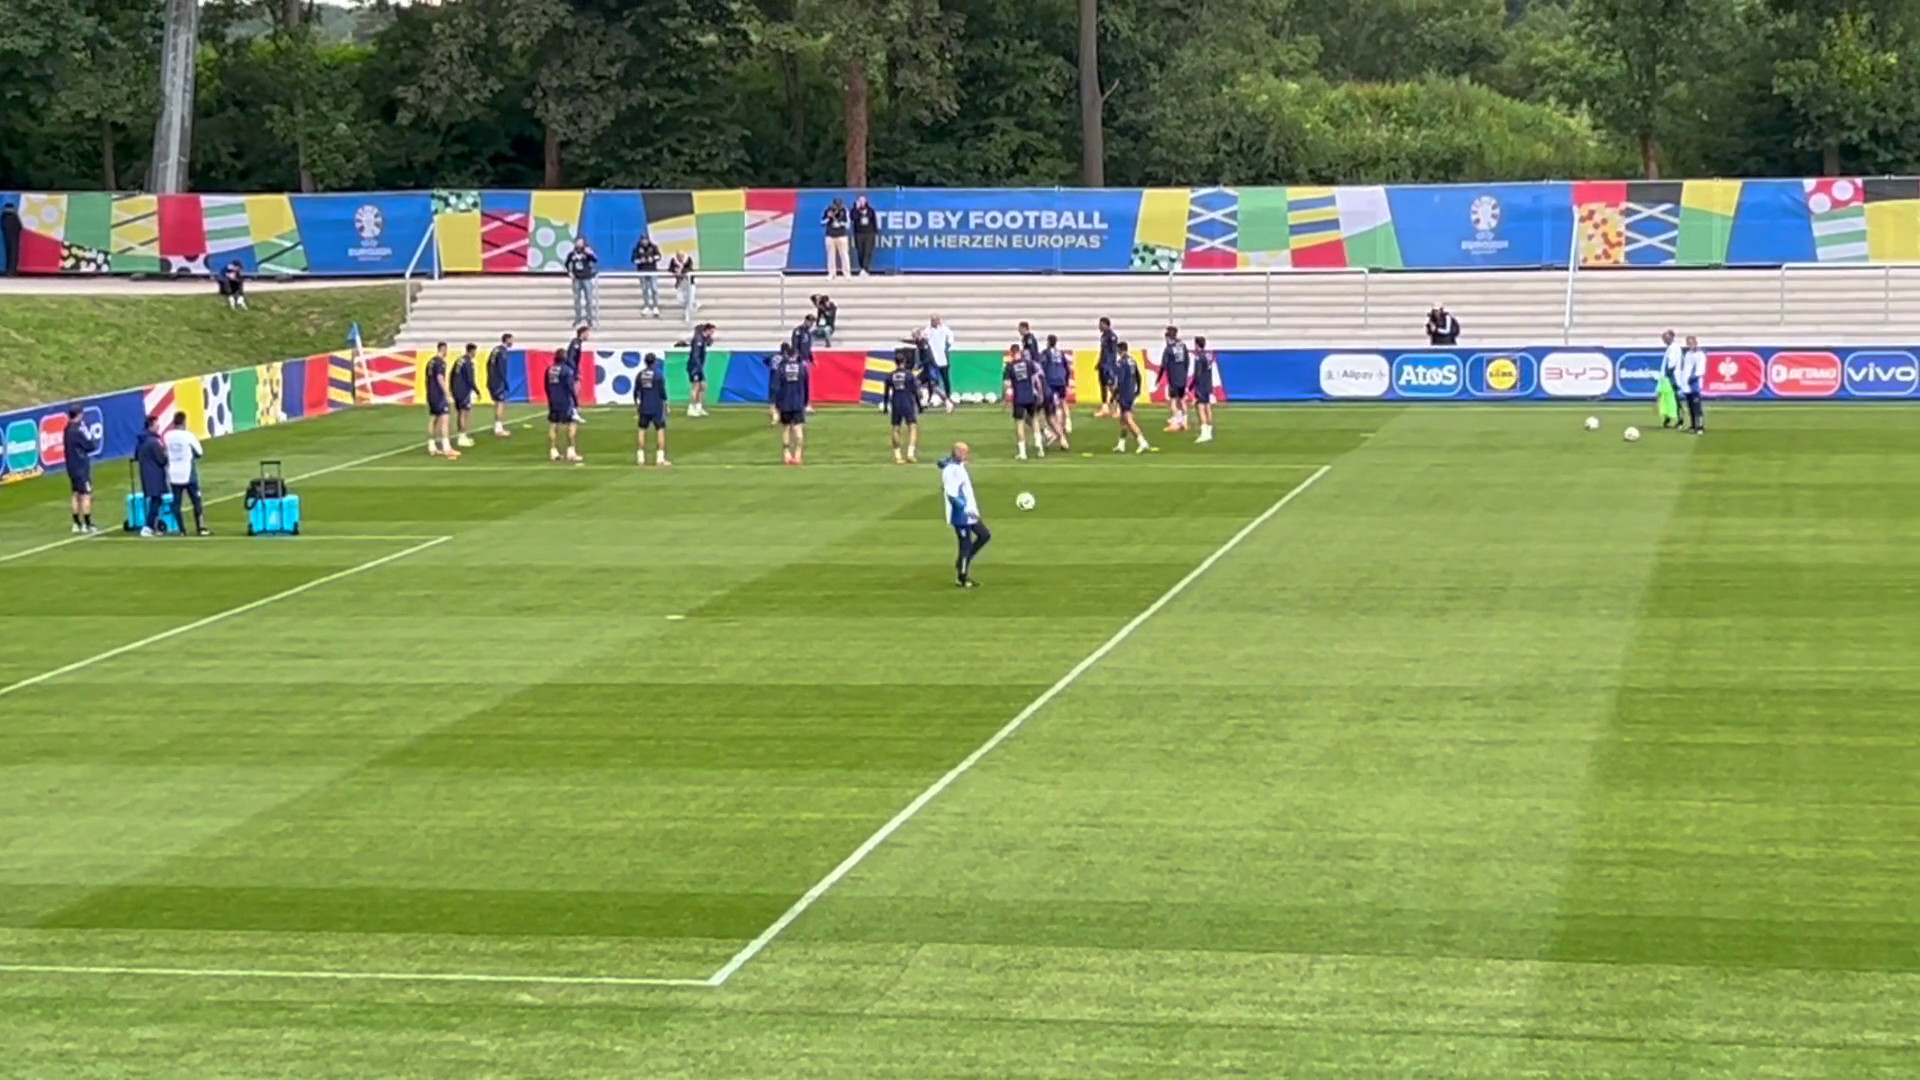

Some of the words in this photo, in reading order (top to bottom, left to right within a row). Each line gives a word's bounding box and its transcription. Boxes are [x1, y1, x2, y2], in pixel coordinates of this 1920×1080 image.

[876, 211, 923, 229] TED
[928, 211, 963, 229] BY
[969, 210, 1109, 229] FOOTBALL
[875, 235, 904, 249] INT
[909, 235, 929, 249] IM
[933, 234, 1008, 249] HERZEN
[1545, 367, 1609, 380] BYD
[1847, 362, 1917, 382] vivo
